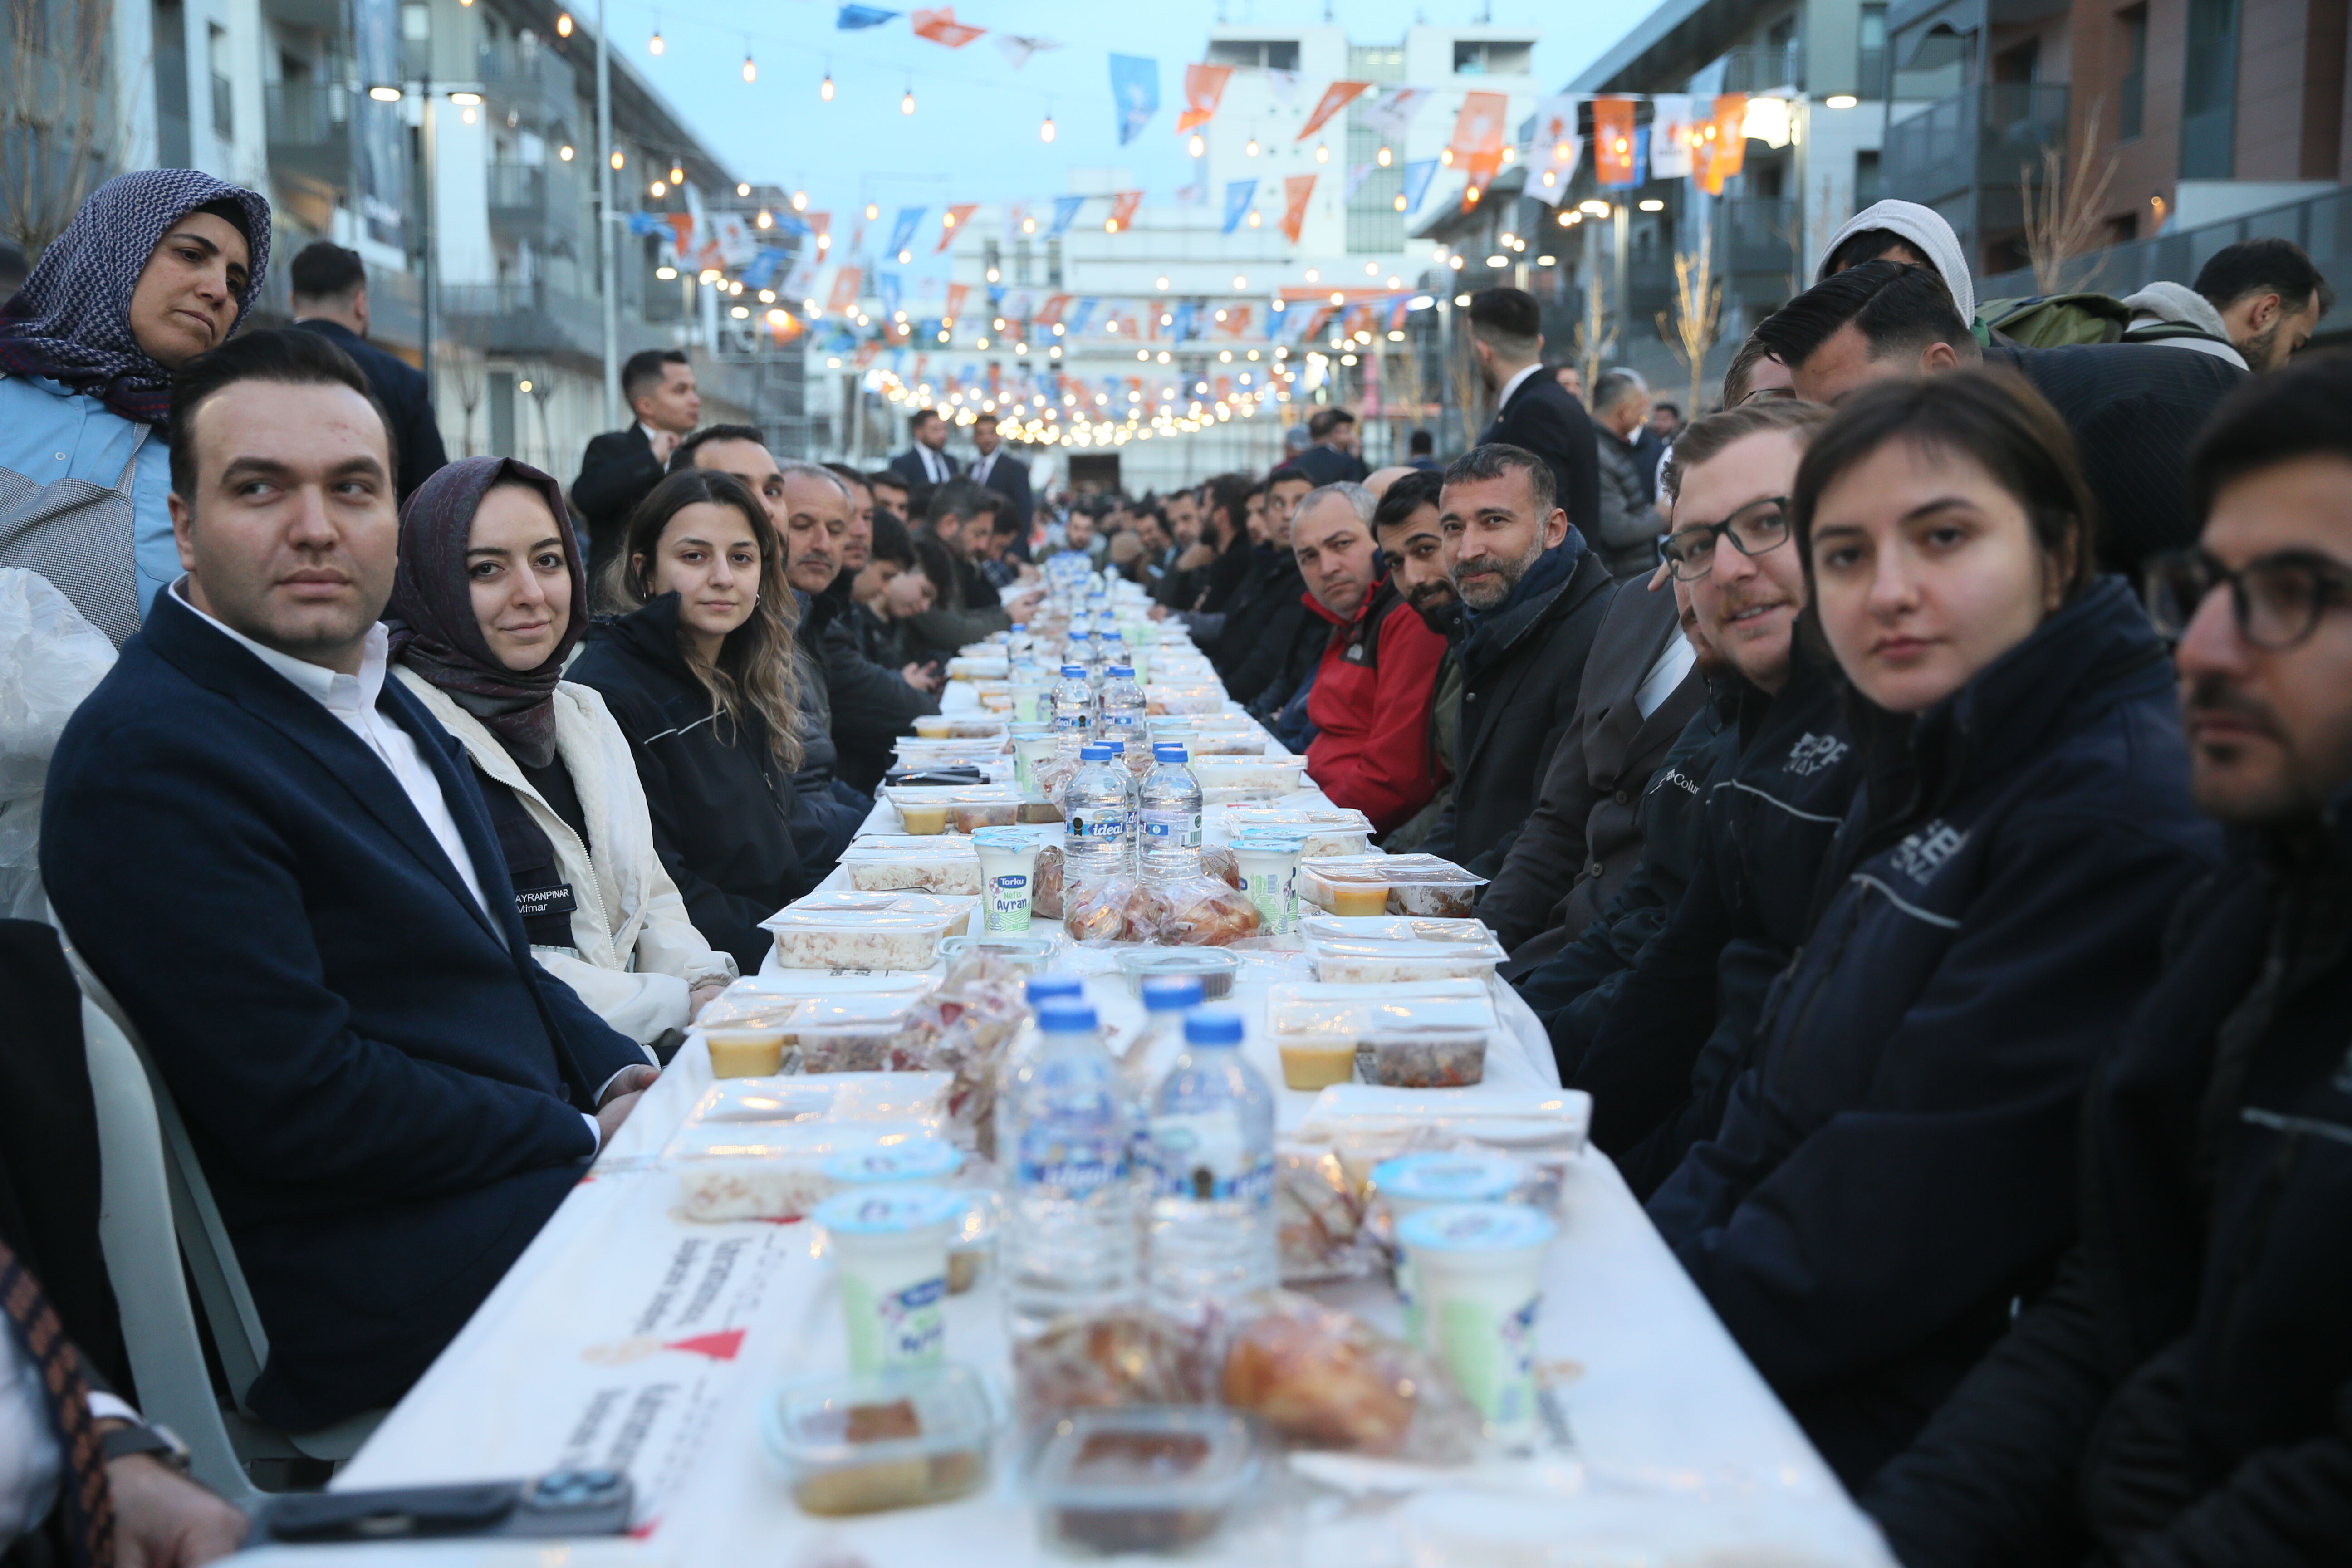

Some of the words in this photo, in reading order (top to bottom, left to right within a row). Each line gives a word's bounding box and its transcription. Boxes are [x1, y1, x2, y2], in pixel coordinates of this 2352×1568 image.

[1093, 822, 1123, 836] ideal
[1000, 877, 1024, 886] Torku
[515, 889, 569, 902] AYRANPINAR
[1004, 891, 1022, 899] Nefis
[997, 898, 1027, 913] Ayran
